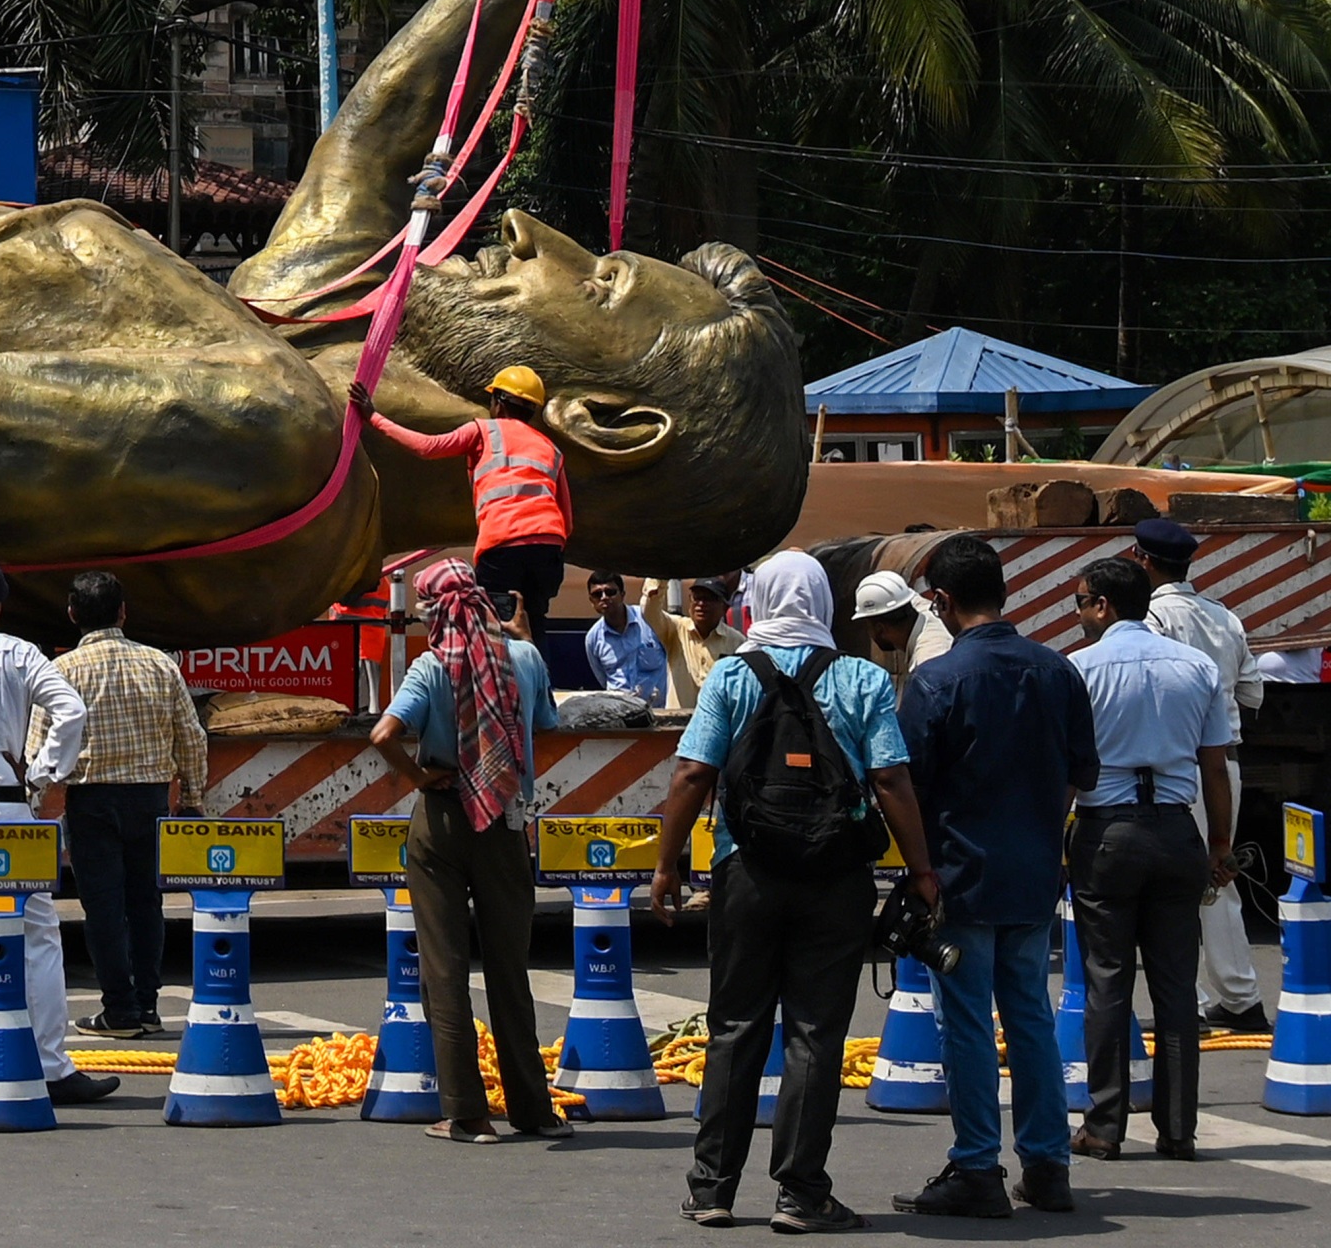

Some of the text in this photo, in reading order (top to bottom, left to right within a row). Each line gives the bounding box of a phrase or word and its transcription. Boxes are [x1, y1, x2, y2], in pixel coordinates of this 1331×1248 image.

[189, 646, 332, 673] PRITAM
[189, 677, 332, 688] SWITCH ON THE GOOD TIMES
[166, 824, 277, 837] UCO BANK
[542, 819, 608, 837] ইউকো
[20, 881, 51, 889] TRUST
[166, 876, 276, 886] HONOURS YOUR TRUST
